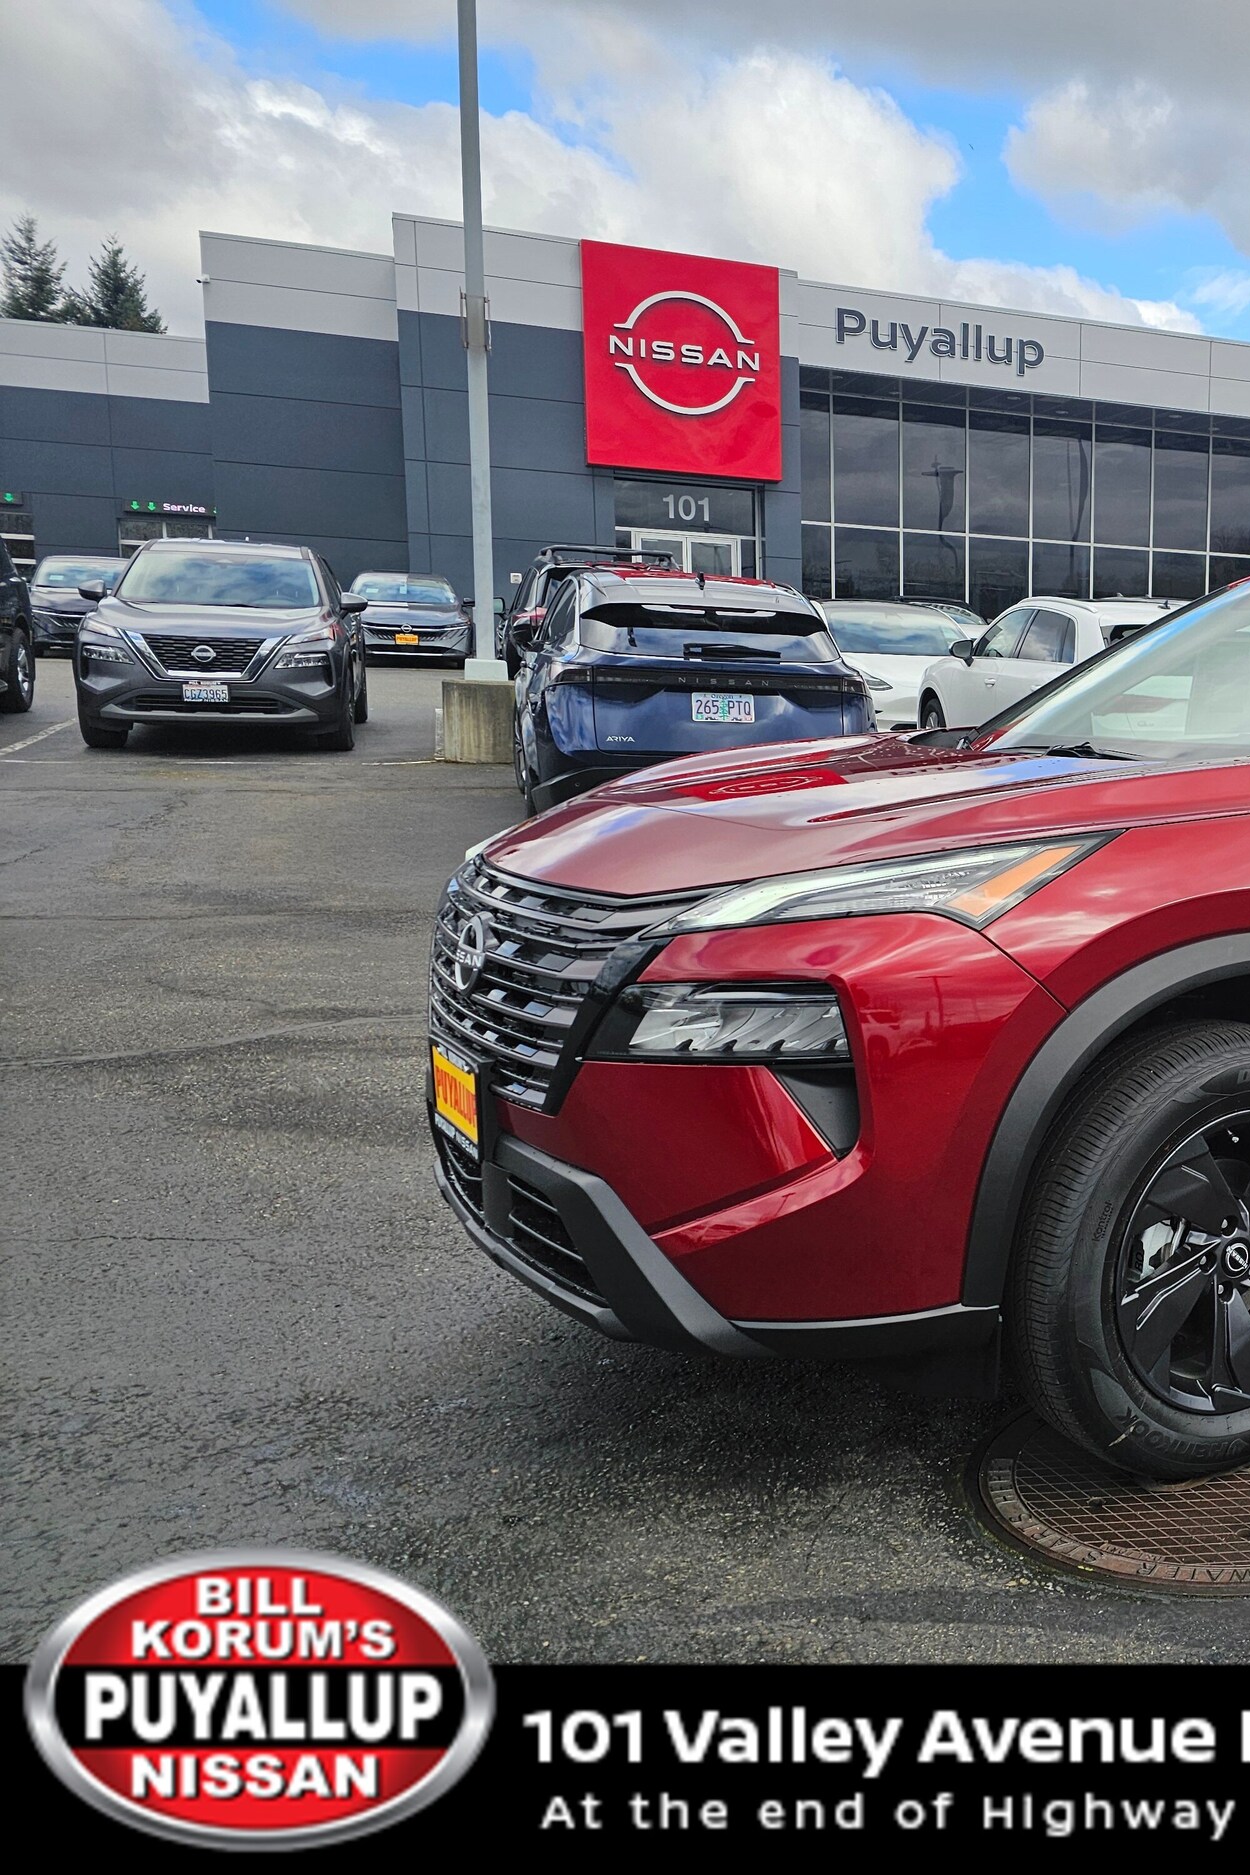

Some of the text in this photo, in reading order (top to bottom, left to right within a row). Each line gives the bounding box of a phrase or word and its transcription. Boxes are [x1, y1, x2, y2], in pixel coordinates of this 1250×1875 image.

[835, 307, 1045, 376] Puyallup
[609, 334, 760, 371] NISSAN
[163, 502, 206, 513] Service
[662, 494, 709, 522] 101
[678, 677, 769, 687] NISSAN
[695, 699, 752, 716] 265 PTQ
[606, 735, 635, 743] ARIYA
[456, 949, 483, 968] SSAN
